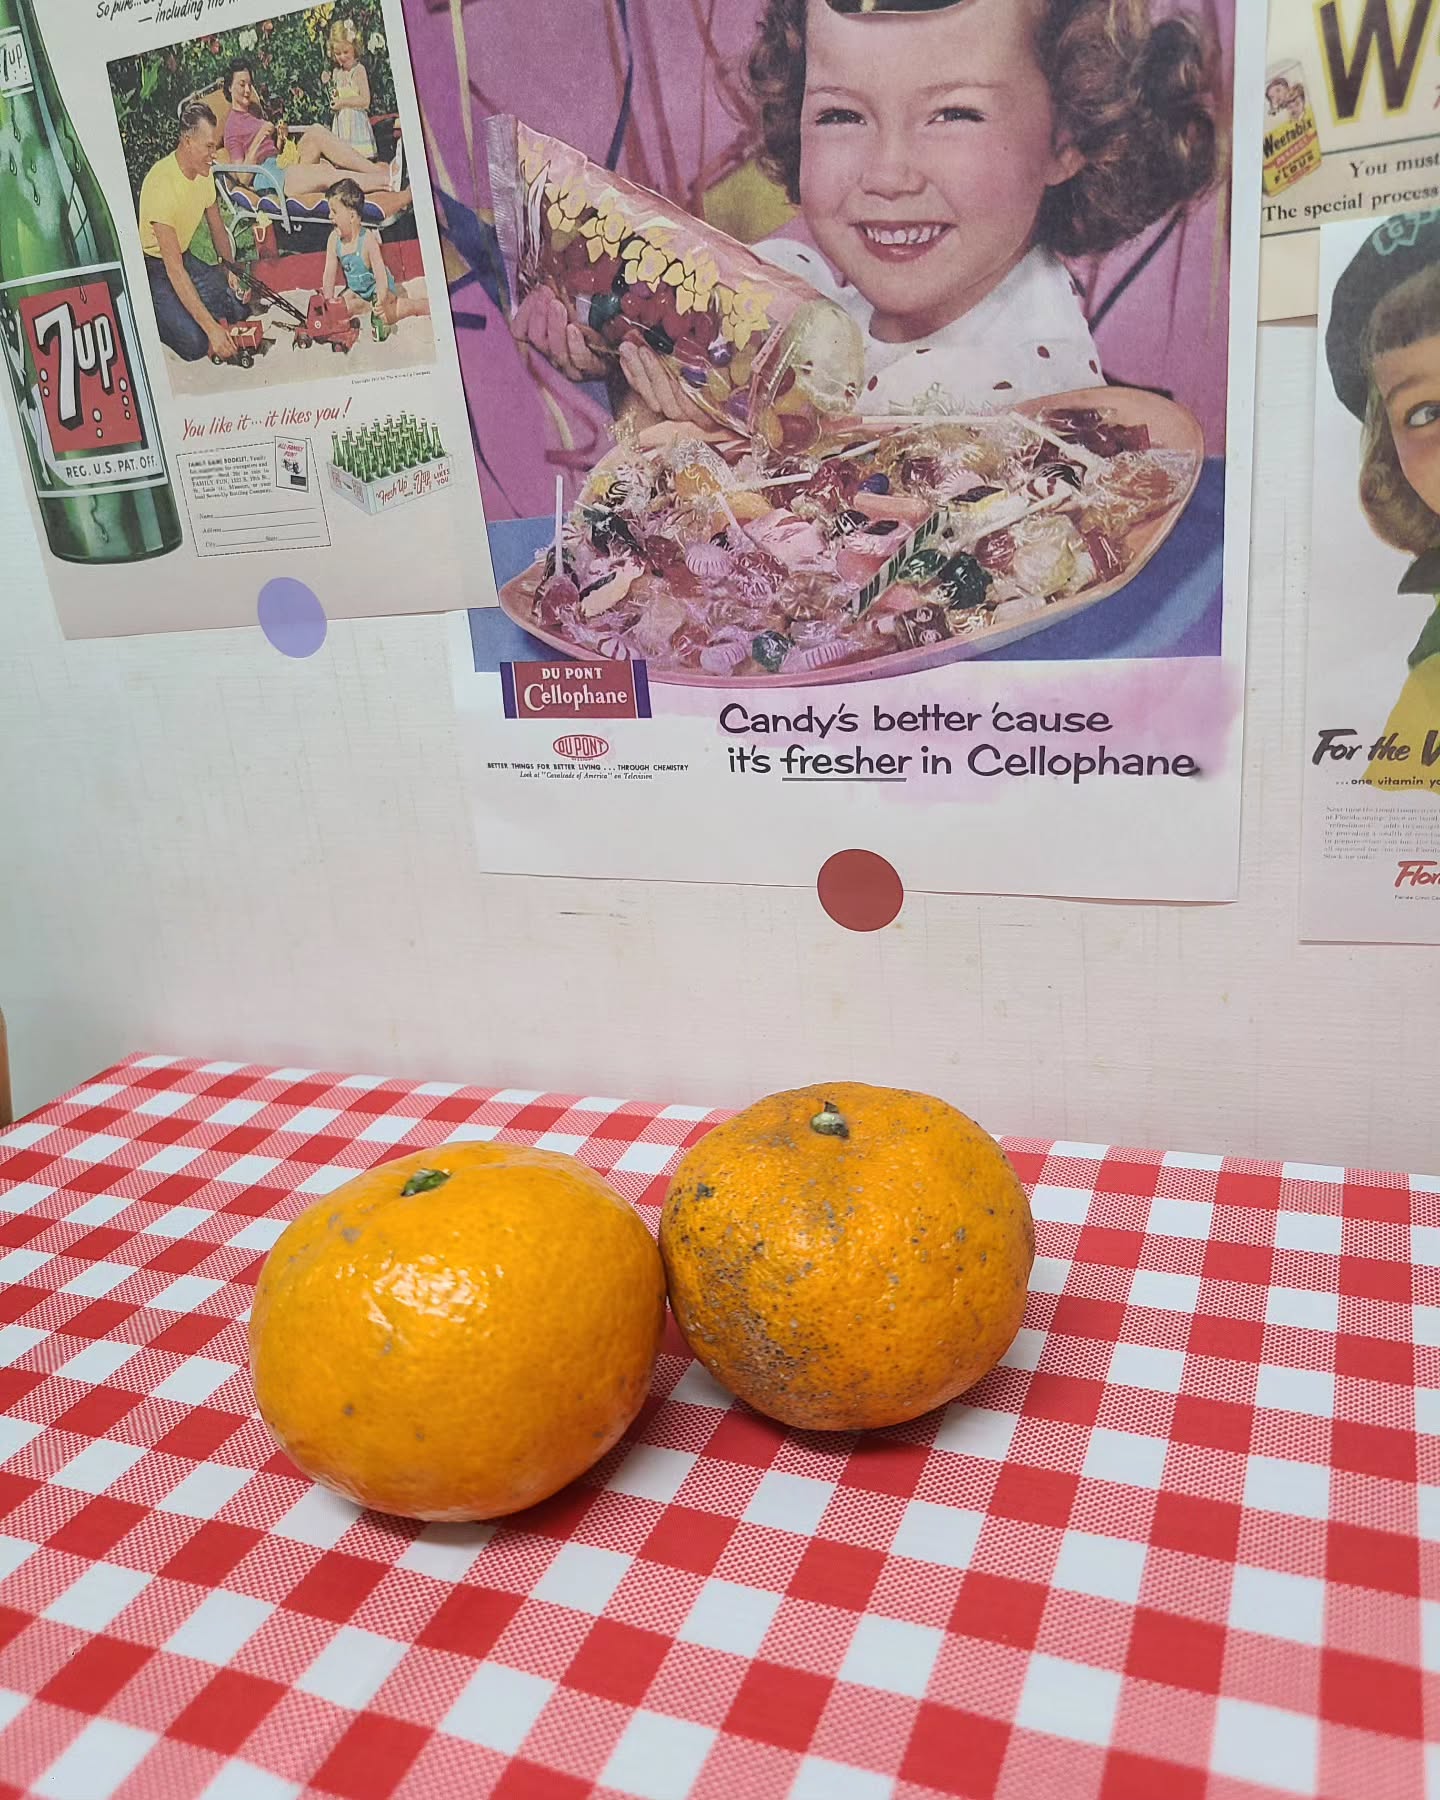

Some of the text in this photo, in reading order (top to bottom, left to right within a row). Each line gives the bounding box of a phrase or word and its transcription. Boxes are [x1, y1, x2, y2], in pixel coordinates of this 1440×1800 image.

[96, 1, 109, 19] So
[156, 0, 202, 23] including
[1349, 159, 1387, 178] You
[1263, 186, 1439, 222] The special process
[33, 302, 118, 431] 7up
[183, 418, 206, 441] You
[209, 416, 233, 435] like
[280, 407, 312, 425] likes
[314, 396, 353, 429] you!
[66, 464, 91, 479] REG.
[118, 458, 138, 473] PAT.
[140, 455, 158, 470] OFF.
[433, 468, 450, 480] LIKES
[436, 476, 449, 487] YOU
[541, 667, 603, 680] DU PONT
[523, 683, 628, 712] Cellophane
[719, 701, 1114, 739] Candy's better 'cause
[558, 737, 604, 757] DU PONT
[1311, 728, 1363, 766] For
[1367, 732, 1411, 762] the
[511, 762, 535, 770] THINGS
[727, 743, 1198, 784] it's fresher in Cellophane
[1378, 776, 1424, 785] vitamin
